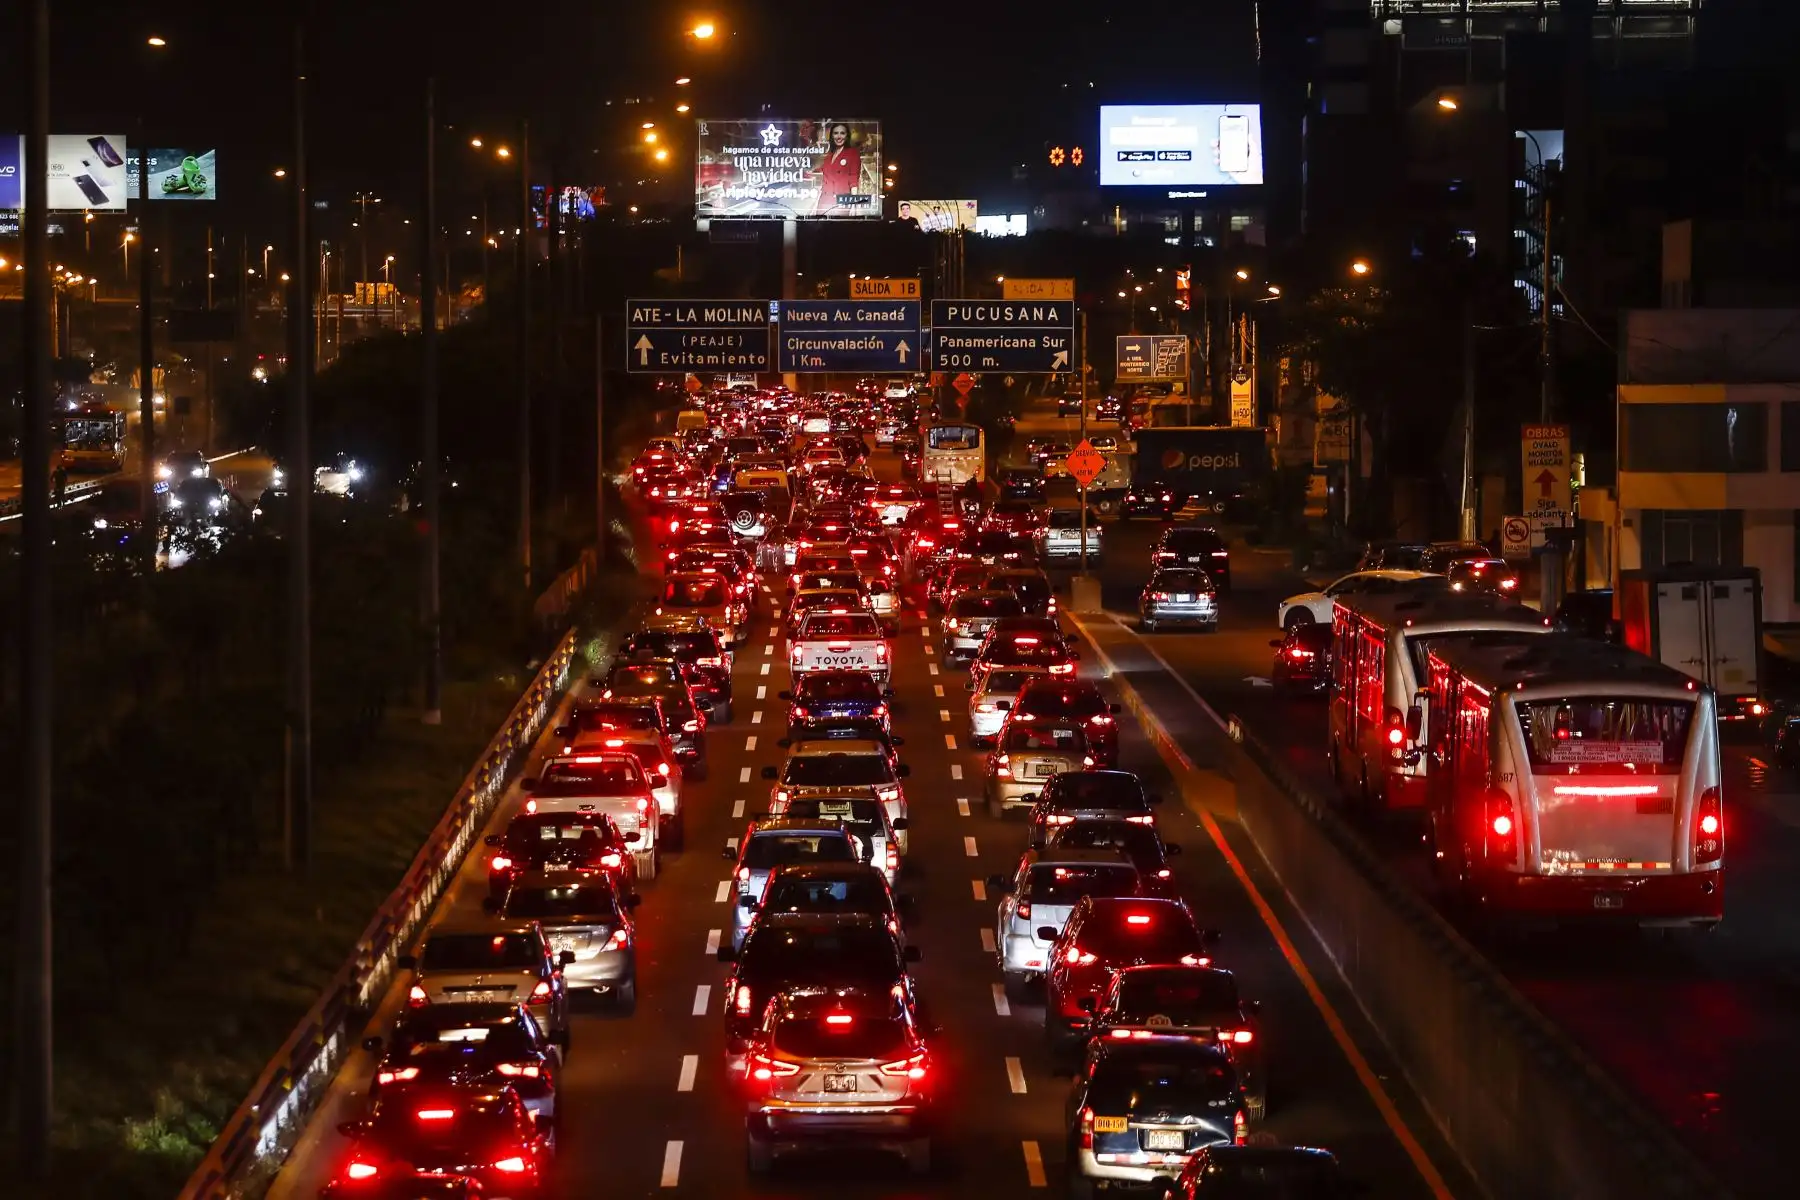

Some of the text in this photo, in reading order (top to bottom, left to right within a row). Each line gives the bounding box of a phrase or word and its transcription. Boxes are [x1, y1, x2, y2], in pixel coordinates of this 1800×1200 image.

[723, 146, 759, 155] hagamos
[761, 146, 772, 154] de
[792, 146, 824, 154] navidad
[734, 155, 811, 171] una nueva
[743, 168, 803, 186] navidad
[855, 282, 891, 295] SALIDA
[704, 308, 764, 322] MOLINA
[787, 309, 828, 321] Nueva
[834, 309, 852, 321] Av.
[857, 306, 906, 321] Canadá
[948, 307, 1058, 321] PUCUSANA
[787, 336, 885, 350] Circunvalación
[940, 335, 1065, 348] Panamericana Sur
[661, 352, 765, 364] Evitamiento
[940, 354, 971, 366] 500
[1526, 428, 1565, 438] OBRAS
[1189, 452, 1240, 472] pepsi
[816, 656, 864, 665] TOYOTA
